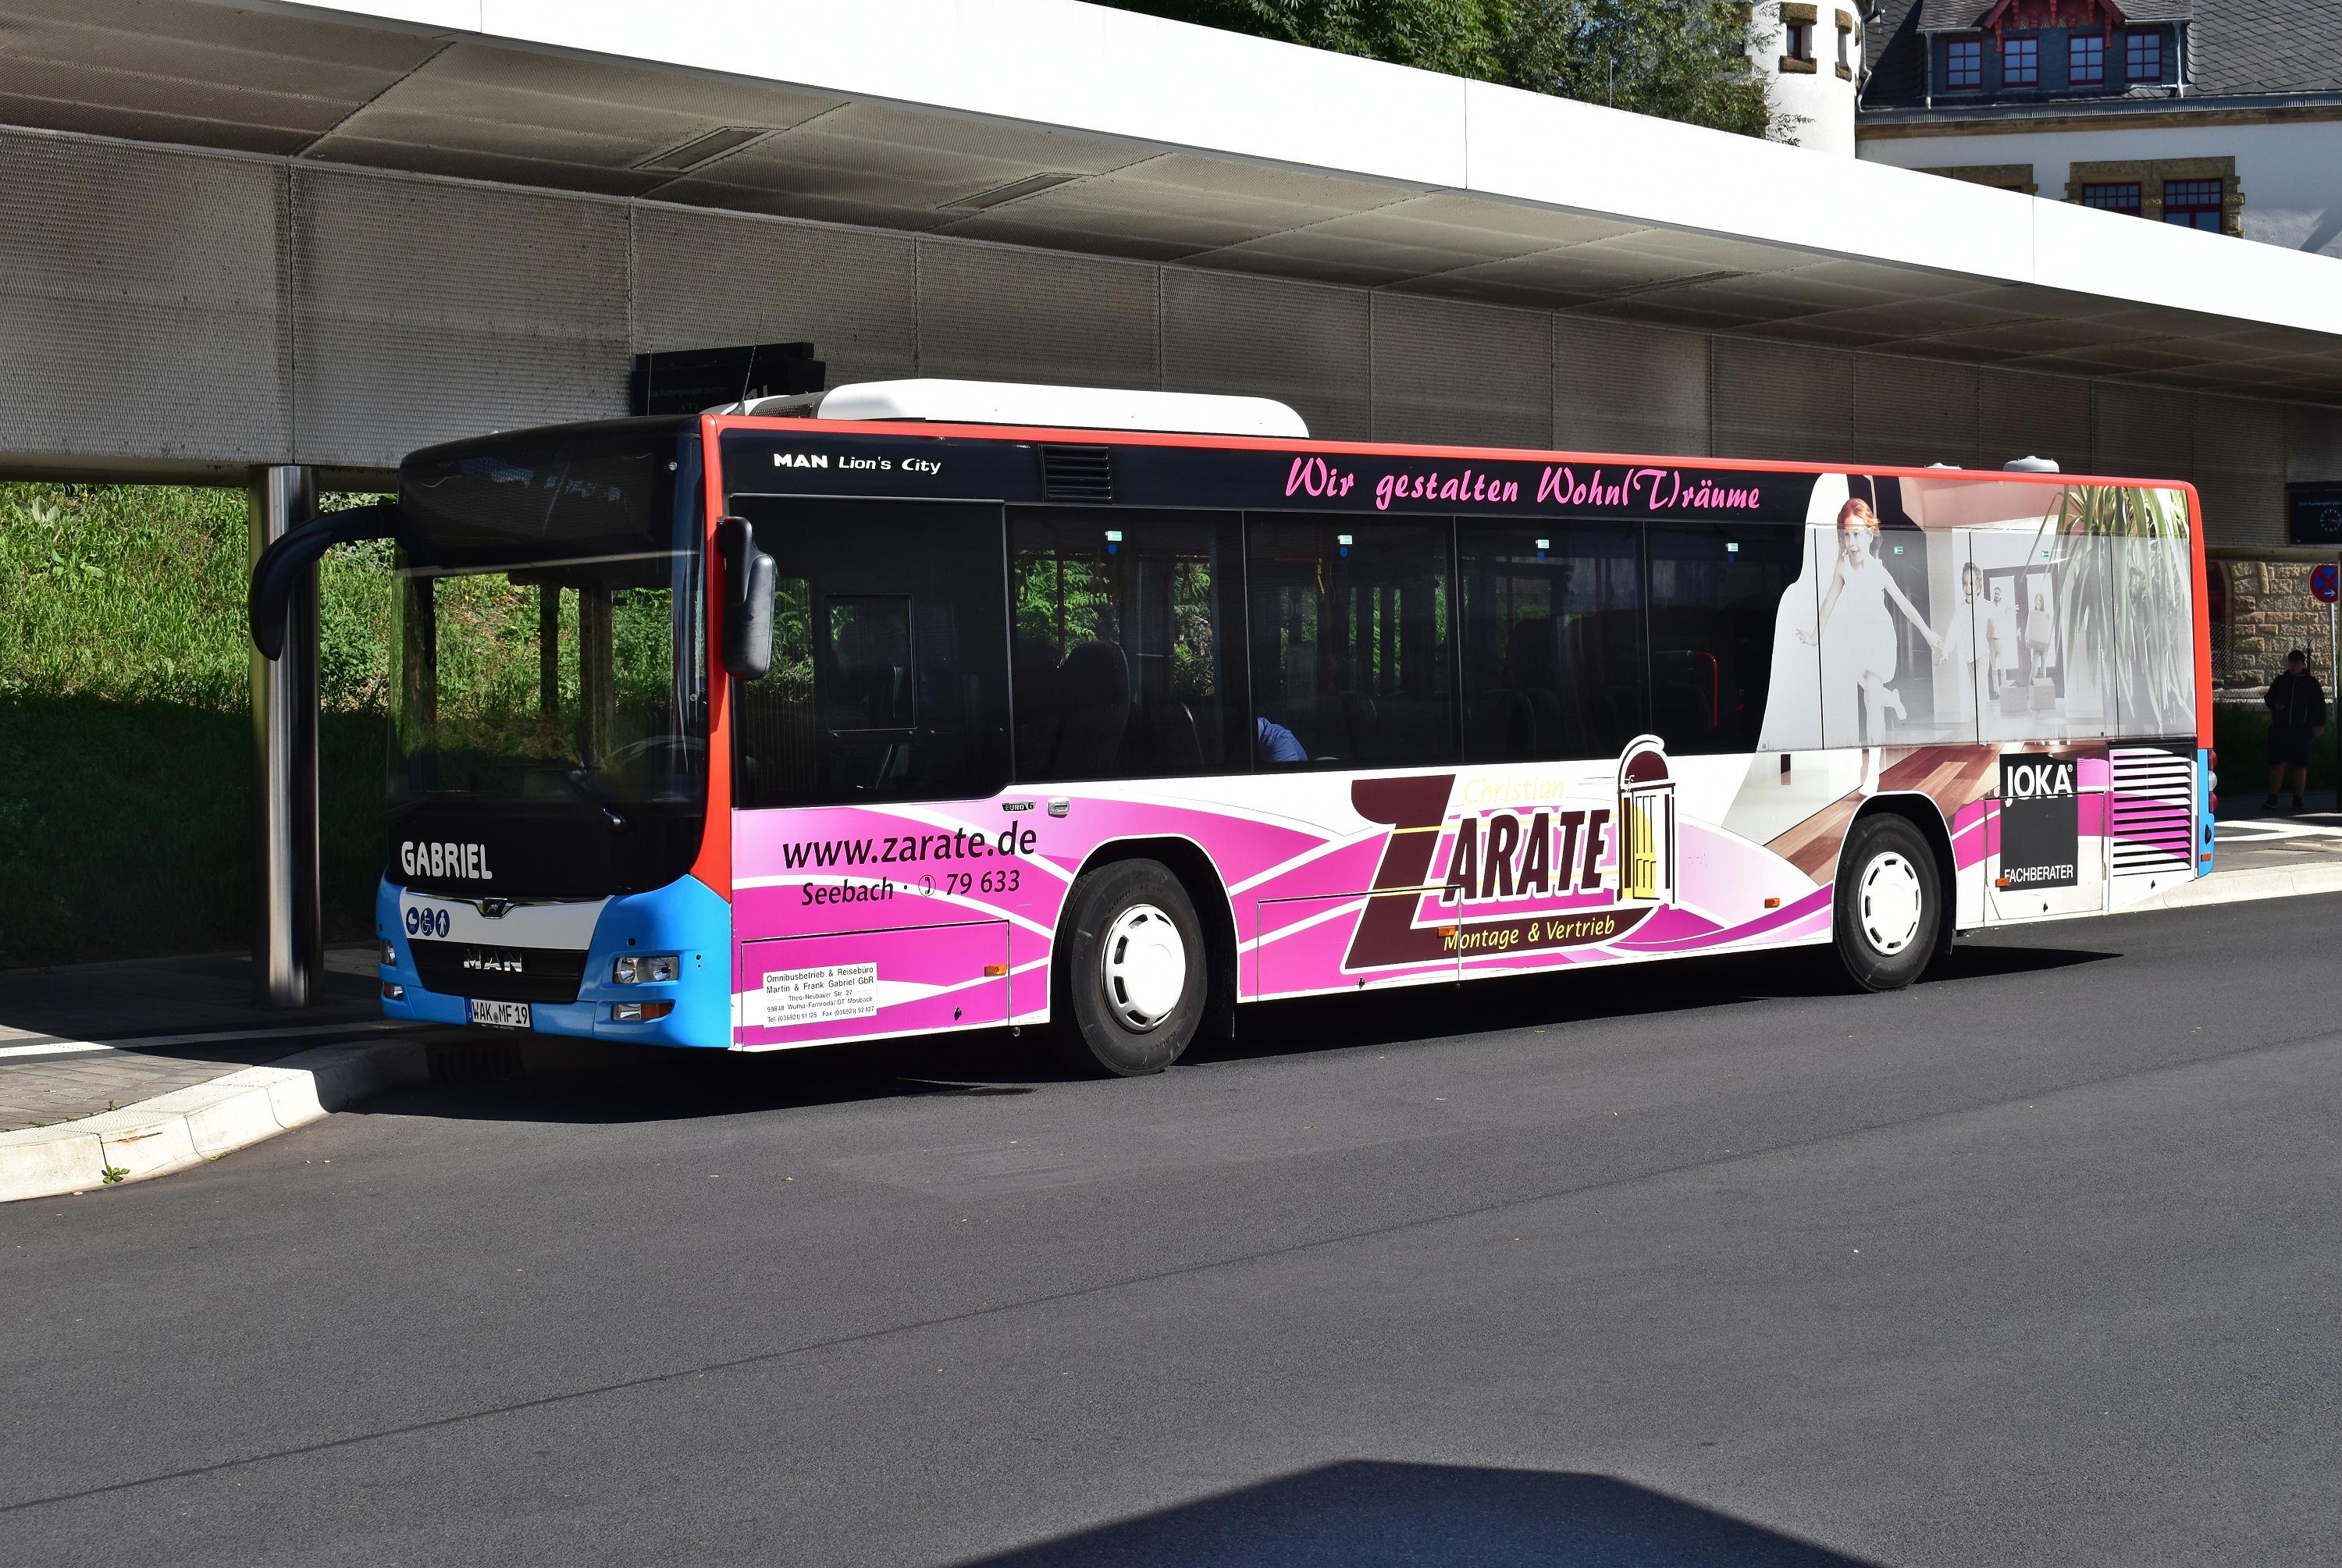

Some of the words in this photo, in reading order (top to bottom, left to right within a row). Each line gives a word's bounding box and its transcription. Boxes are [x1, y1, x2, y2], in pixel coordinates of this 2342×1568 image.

[773, 453, 828, 468] MAN
[838, 456, 892, 470] Lion's
[901, 458, 941, 475] City
[1285, 457, 1354, 497] Wir
[1376, 469, 1518, 510] gestalten
[1464, 777, 1564, 804] Christian
[782, 820, 1038, 869] www.zarate.de
[400, 841, 493, 880] GABRIEL
[1344, 773, 1616, 970] ZARATE
[2004, 864, 2073, 883] FACHBERATER
[802, 876, 894, 906] Seebach
[945, 873, 973, 895] 79
[981, 869, 1020, 894] 633
[1443, 924, 1519, 951] Montage
[1527, 922, 1540, 942] &
[1547, 915, 1615, 940] Vertrieb
[464, 948, 522, 972] MAN
[766, 970, 824, 983] Omnibusbetrieb
[838, 965, 874, 976] Reisebüro
[766, 984, 791, 994] Martin
[803, 981, 824, 990] Frank
[828, 978, 855, 988] Gabriel
[858, 976, 874, 985] GbR
[847, 996, 873, 1004] Mosbach
[472, 1001, 493, 1022] WAK
[498, 1004, 512, 1023] MF
[514, 1005, 528, 1025] 19
